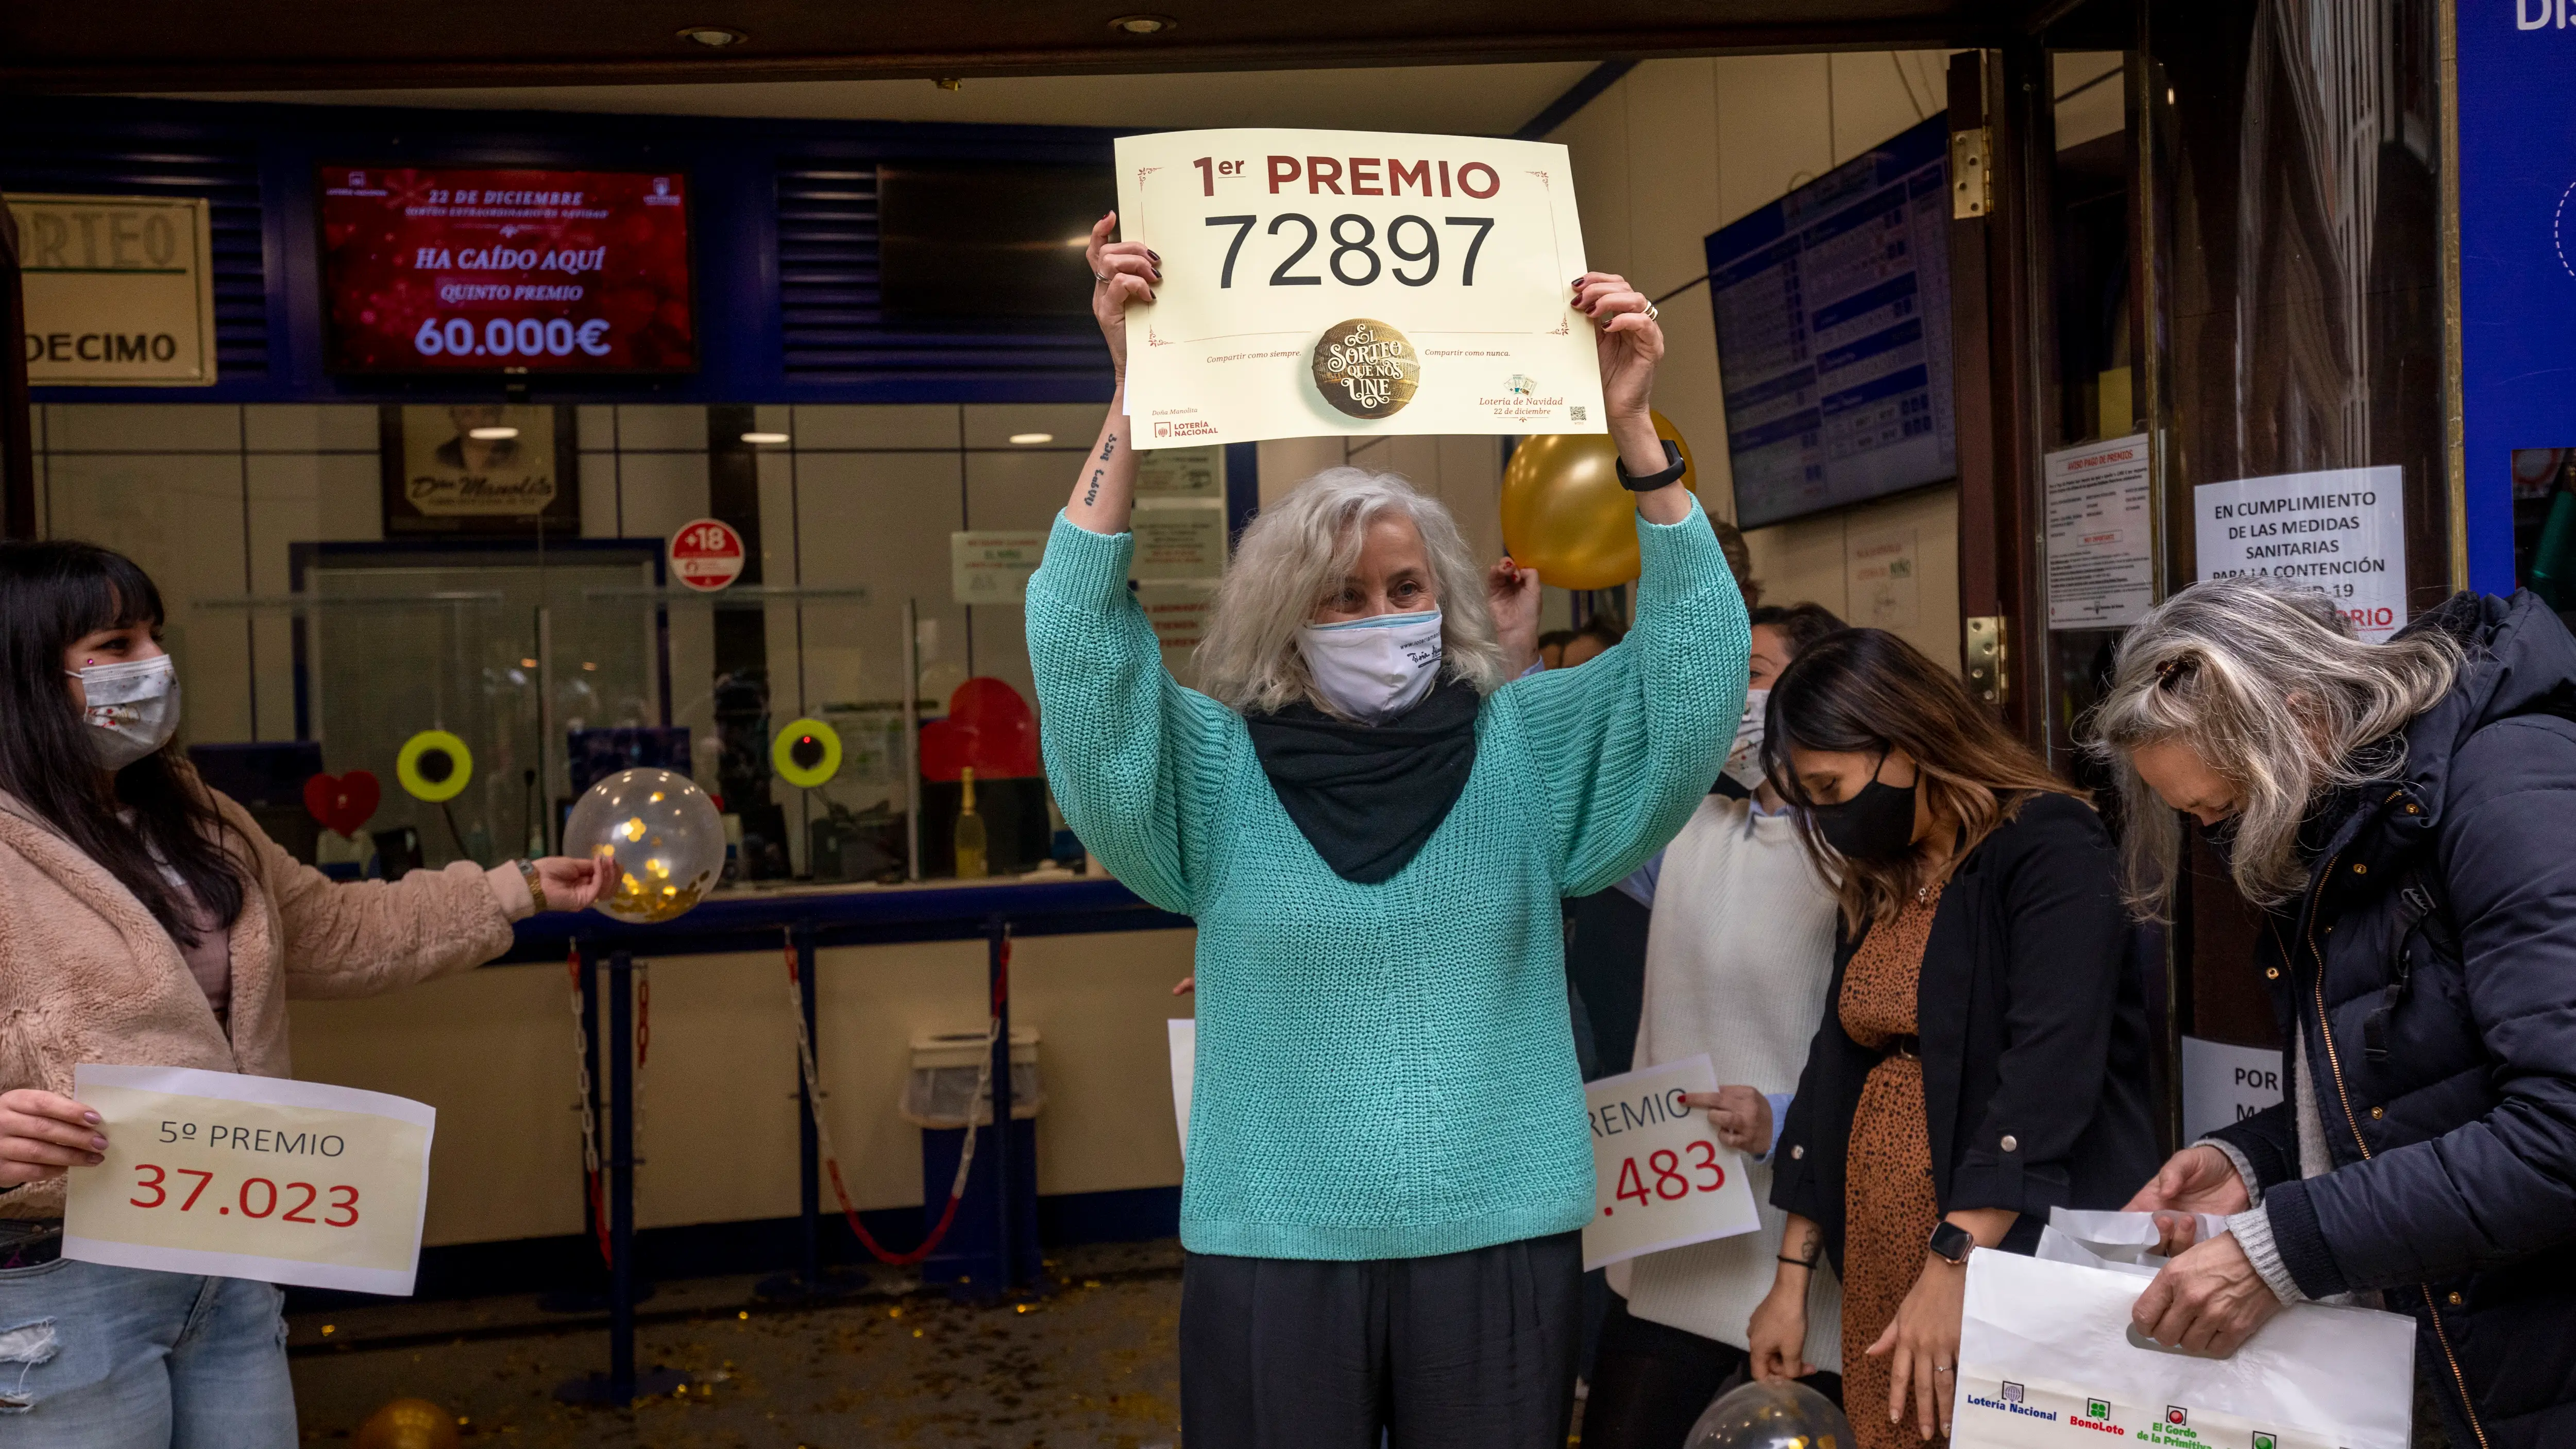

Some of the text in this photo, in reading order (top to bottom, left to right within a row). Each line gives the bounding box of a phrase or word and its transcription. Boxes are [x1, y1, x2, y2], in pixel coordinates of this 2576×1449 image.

[2517, 0, 2576, 30] DI
[1193, 156, 1500, 199] 1er PREMIO
[428, 190, 584, 206] 22 DE DICIEMBRE
[18, 210, 176, 267] RTEO
[1205, 213, 1495, 288] 72897
[415, 245, 606, 275] HA CAÍDO AQUÍ
[440, 284, 583, 303] QUINTO PREMIO
[415, 317, 612, 356] 60.000€
[1207, 352, 1246, 363] Compartir
[1270, 350, 1301, 359] siempre.
[1328, 340, 1402, 372] SORTEO
[1347, 360, 1403, 380] QUE NOS
[1341, 378, 1391, 408] UNE
[1479, 397, 1511, 405] Lotería
[1174, 420, 1209, 430] LOTERÍA
[1174, 428, 1218, 437] NACIONAL
[2215, 491, 2376, 519] EN CUMPLIMIENTO
[685, 526, 726, 551] +18
[2229, 516, 2360, 540] DE LAS MEDIDAS
[2246, 539, 2340, 560] SANITARIAS
[2273, 556, 2385, 578] CONTENCIÓN
[2235, 1067, 2278, 1090] POR
[1588, 1088, 1691, 1138] REMIO
[210, 1124, 345, 1157] PREMIO
[1603, 1140, 1726, 1216] .483
[130, 1164, 360, 1228] 37.023
[1968, 1394, 2057, 1422] Lotería Nacional
[2070, 1416, 2125, 1436] BonoLoto
[2137, 1430, 2149, 1441] de
[2151, 1433, 2161, 1443] la
[2152, 1422, 2197, 1438] El Gordo
